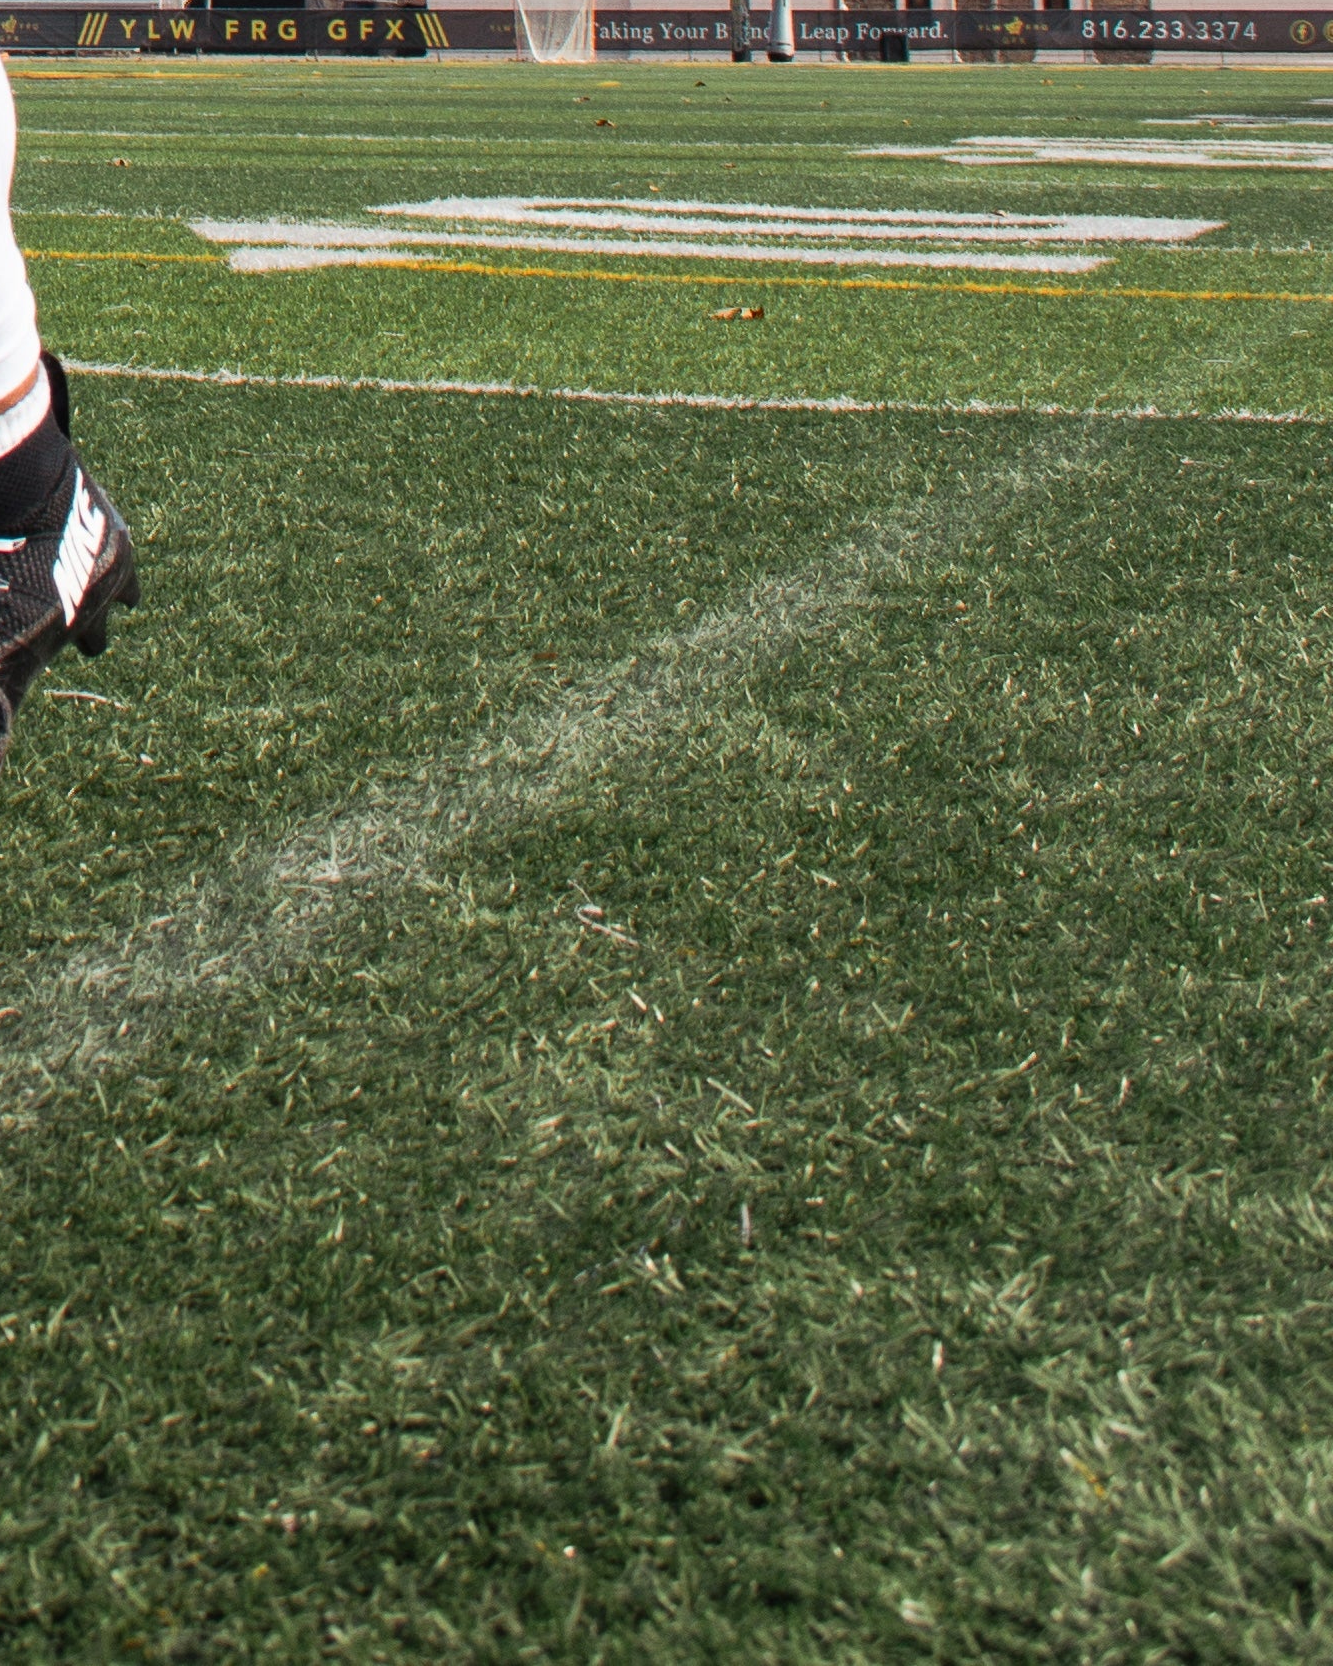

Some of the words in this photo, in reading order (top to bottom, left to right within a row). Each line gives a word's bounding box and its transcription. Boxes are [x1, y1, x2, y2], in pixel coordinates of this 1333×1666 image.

[120, 18, 196, 41] YLW
[225, 19, 298, 42] FRG
[327, 19, 406, 42] GFX
[594, 21, 654, 44] aking
[659, 22, 709, 40] Your
[800, 22, 849, 43] Leap
[1081, 19, 1258, 42] 816.233.3374
[53, 467, 106, 628] NIKE
